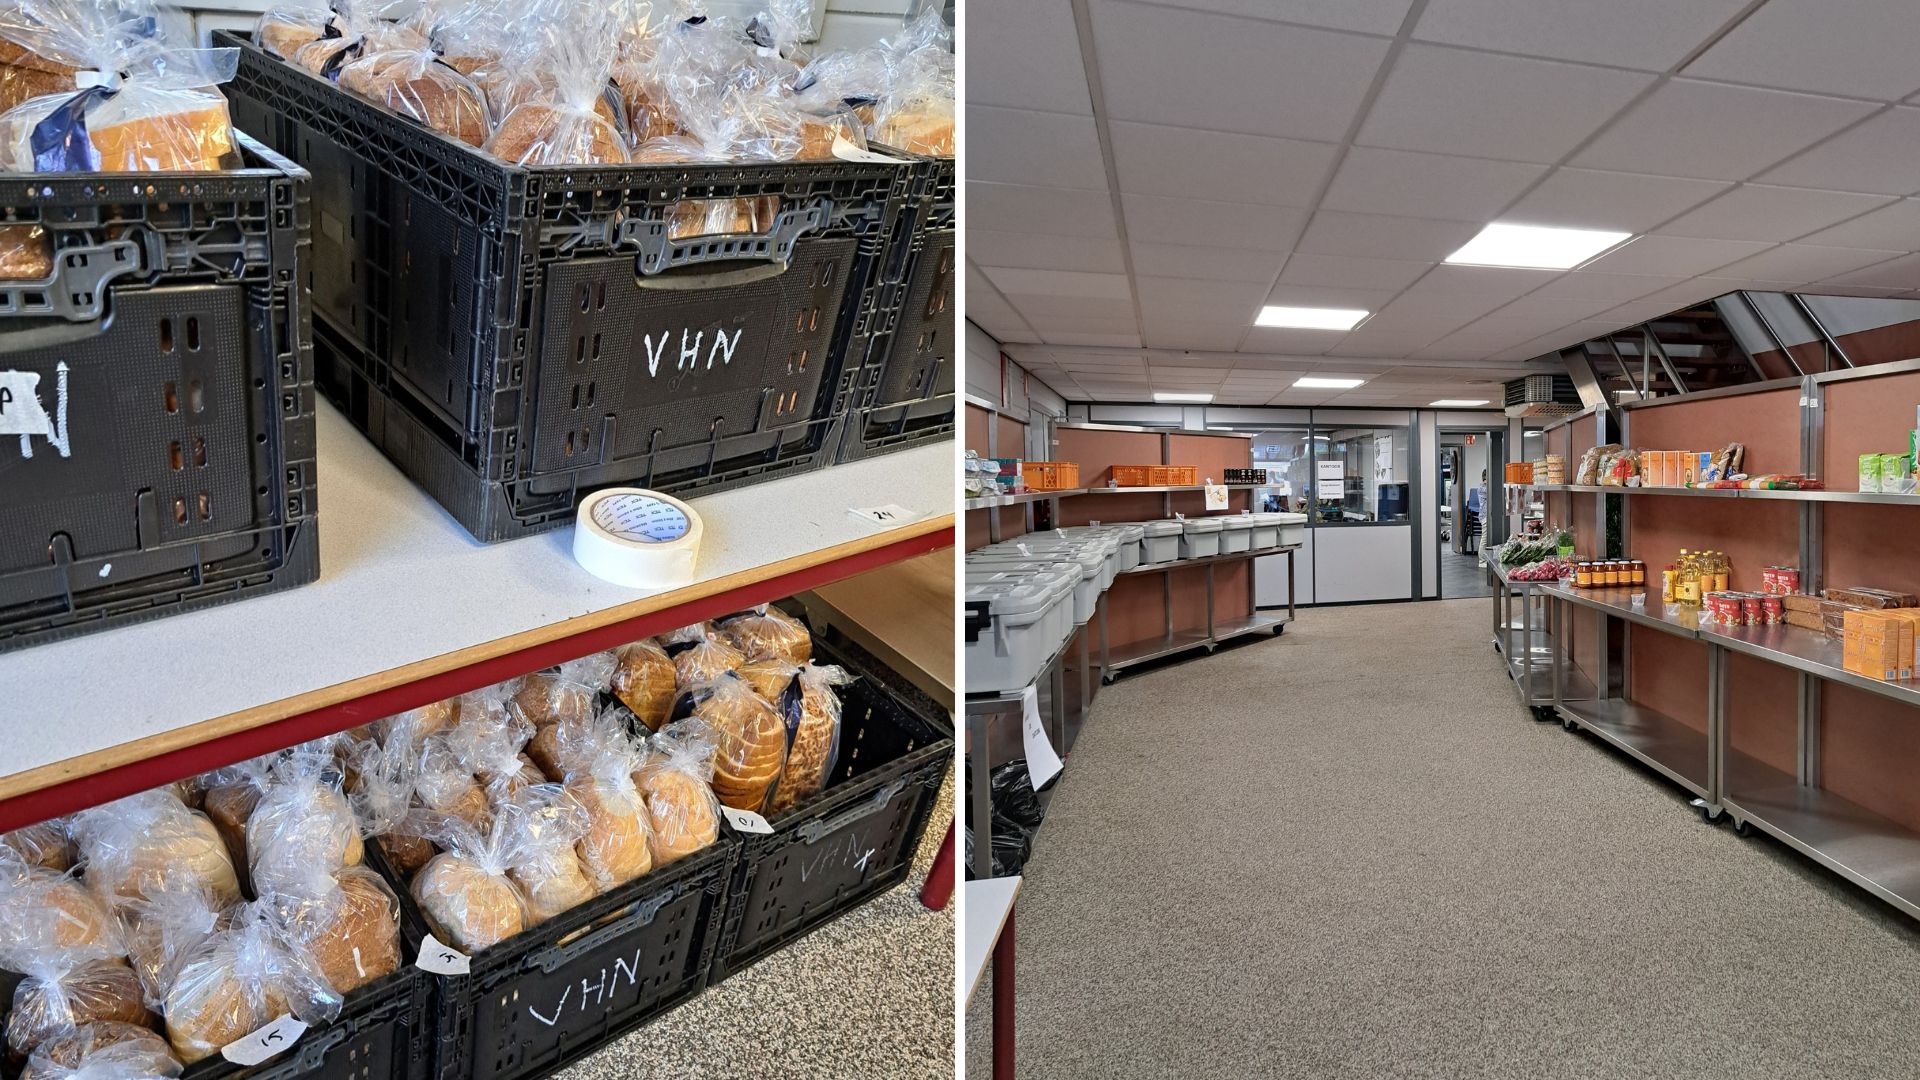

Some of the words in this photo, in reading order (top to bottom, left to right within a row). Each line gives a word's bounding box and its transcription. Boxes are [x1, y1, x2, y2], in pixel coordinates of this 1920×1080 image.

[644, 327, 742, 378] VHN
[873, 511, 896, 521] 24
[529, 948, 641, 1026] VHN
[261, 1028, 283, 1047] 15
